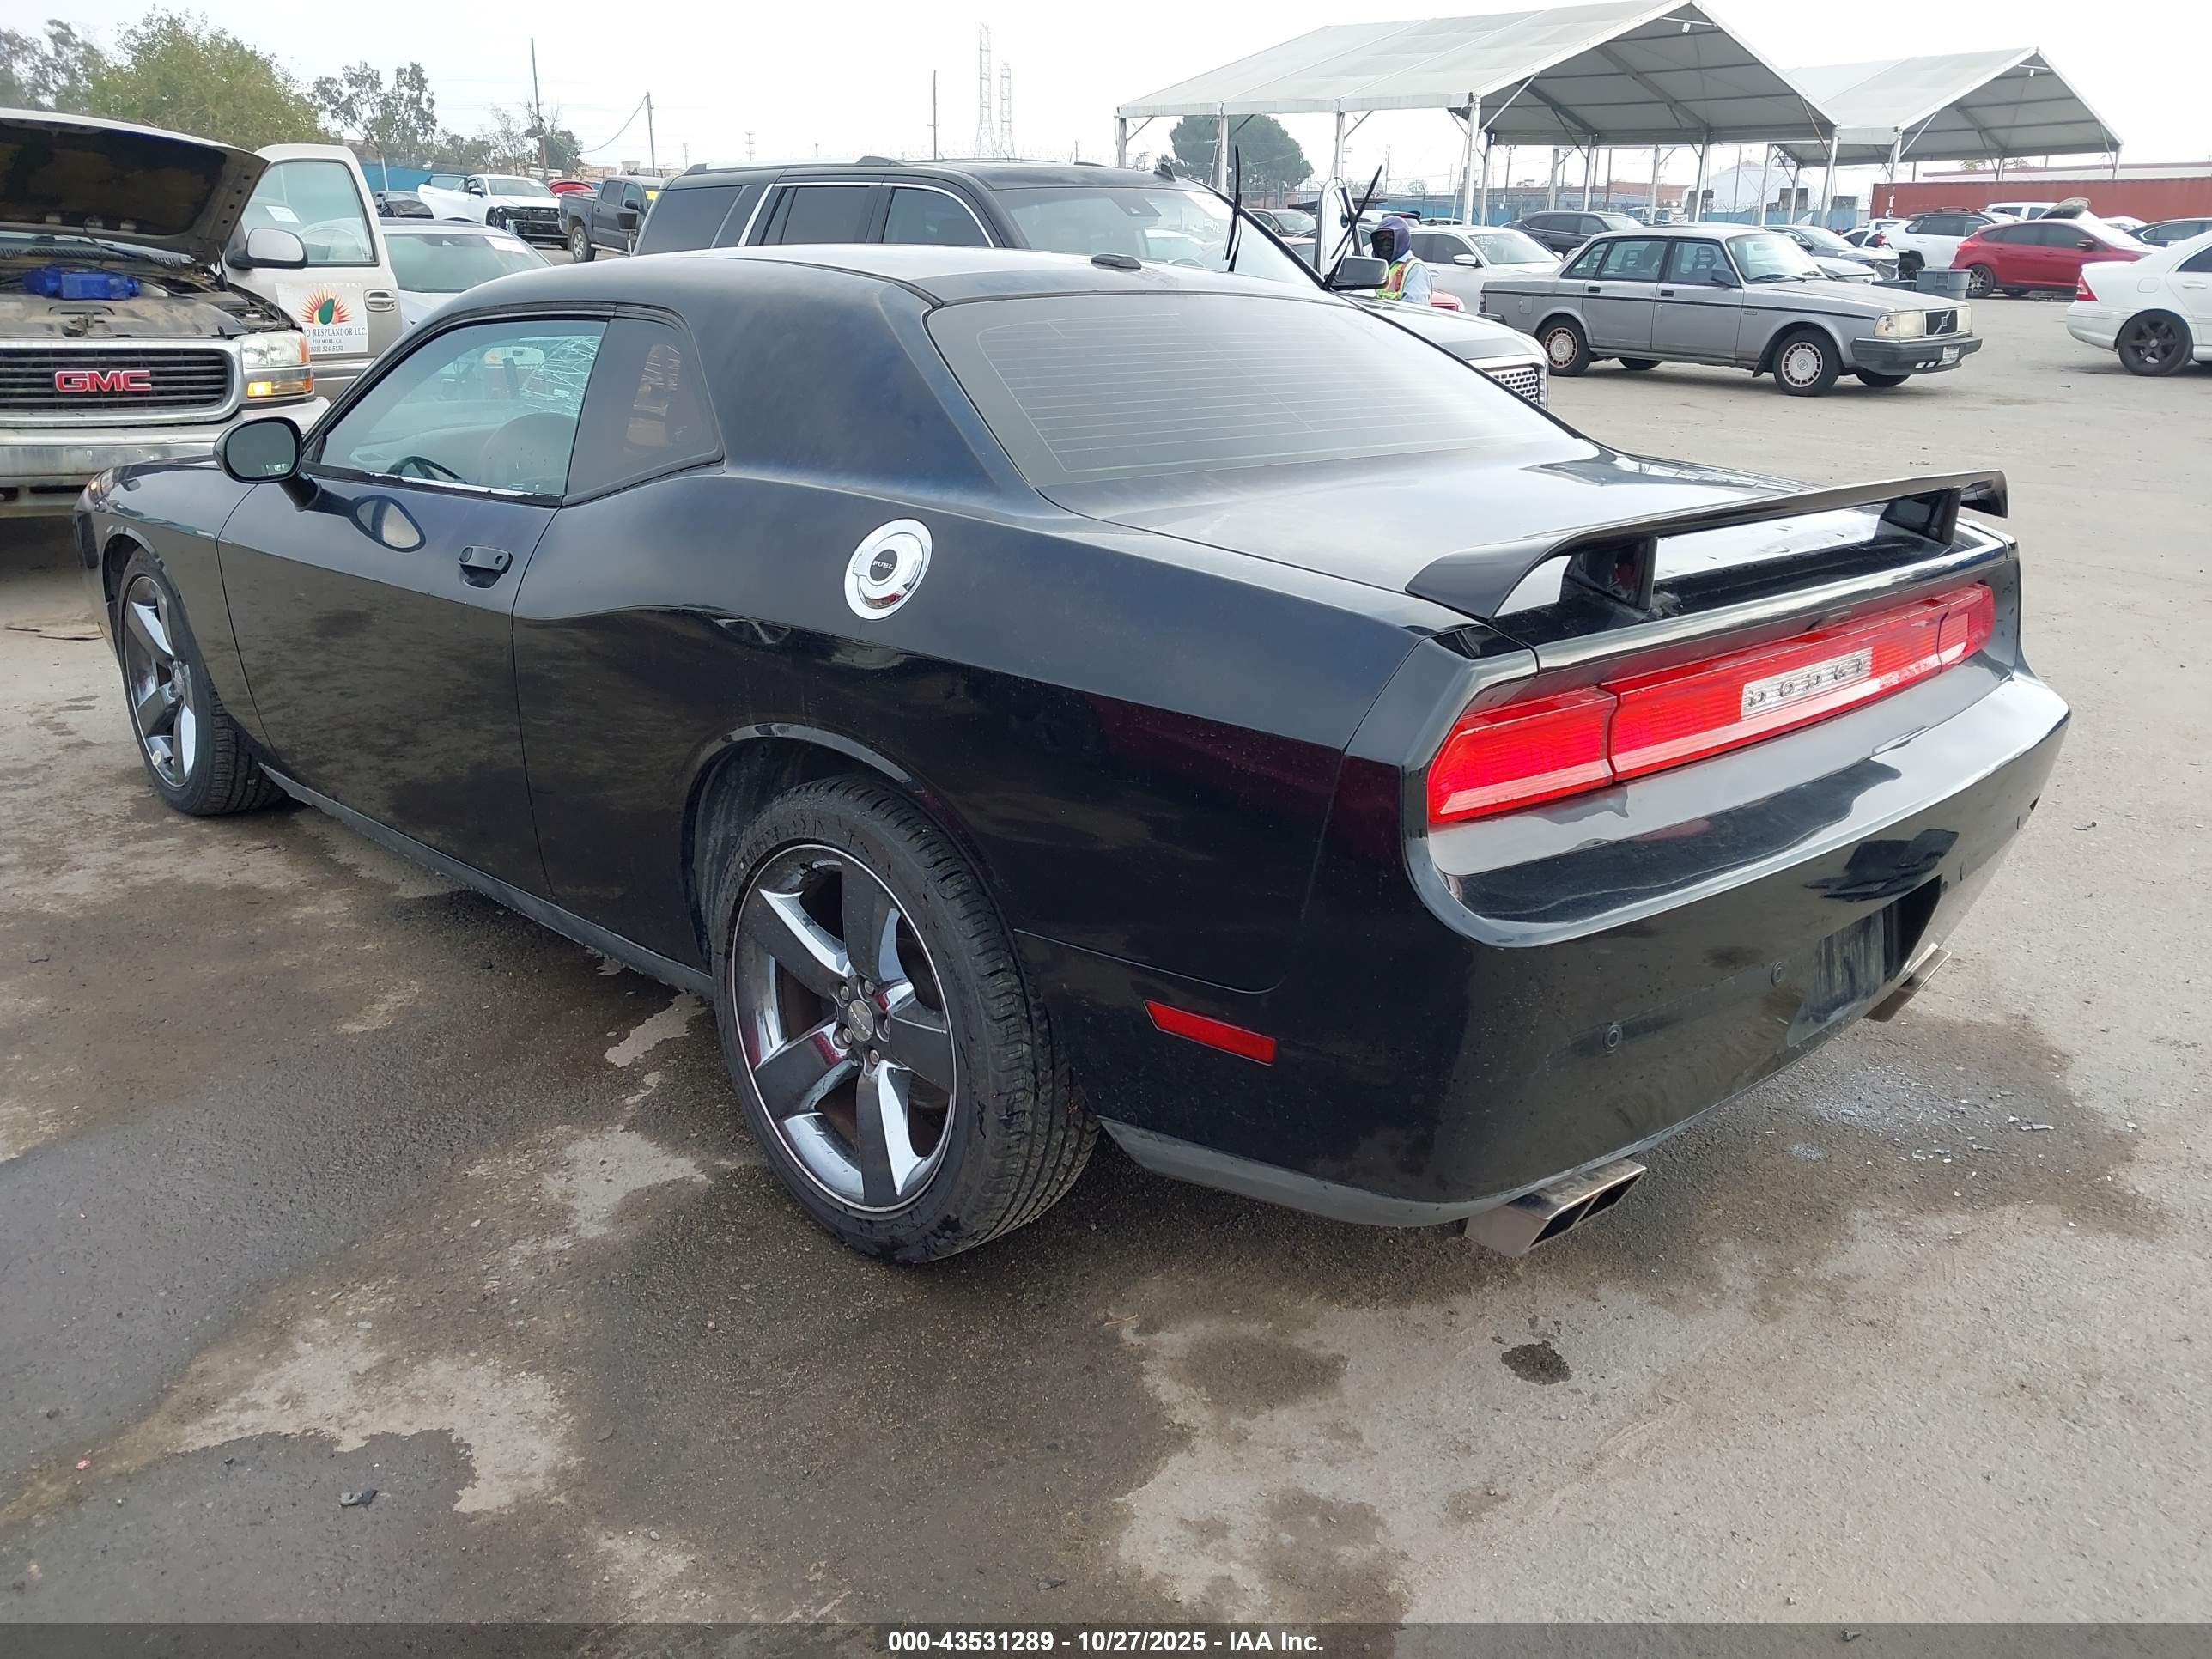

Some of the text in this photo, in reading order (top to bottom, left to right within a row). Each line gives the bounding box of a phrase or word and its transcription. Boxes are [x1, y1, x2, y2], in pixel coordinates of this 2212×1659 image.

[313, 328, 353, 337] RESPLANDOR
[55, 370, 152, 392] GMC
[872, 560, 894, 570] FUEL
